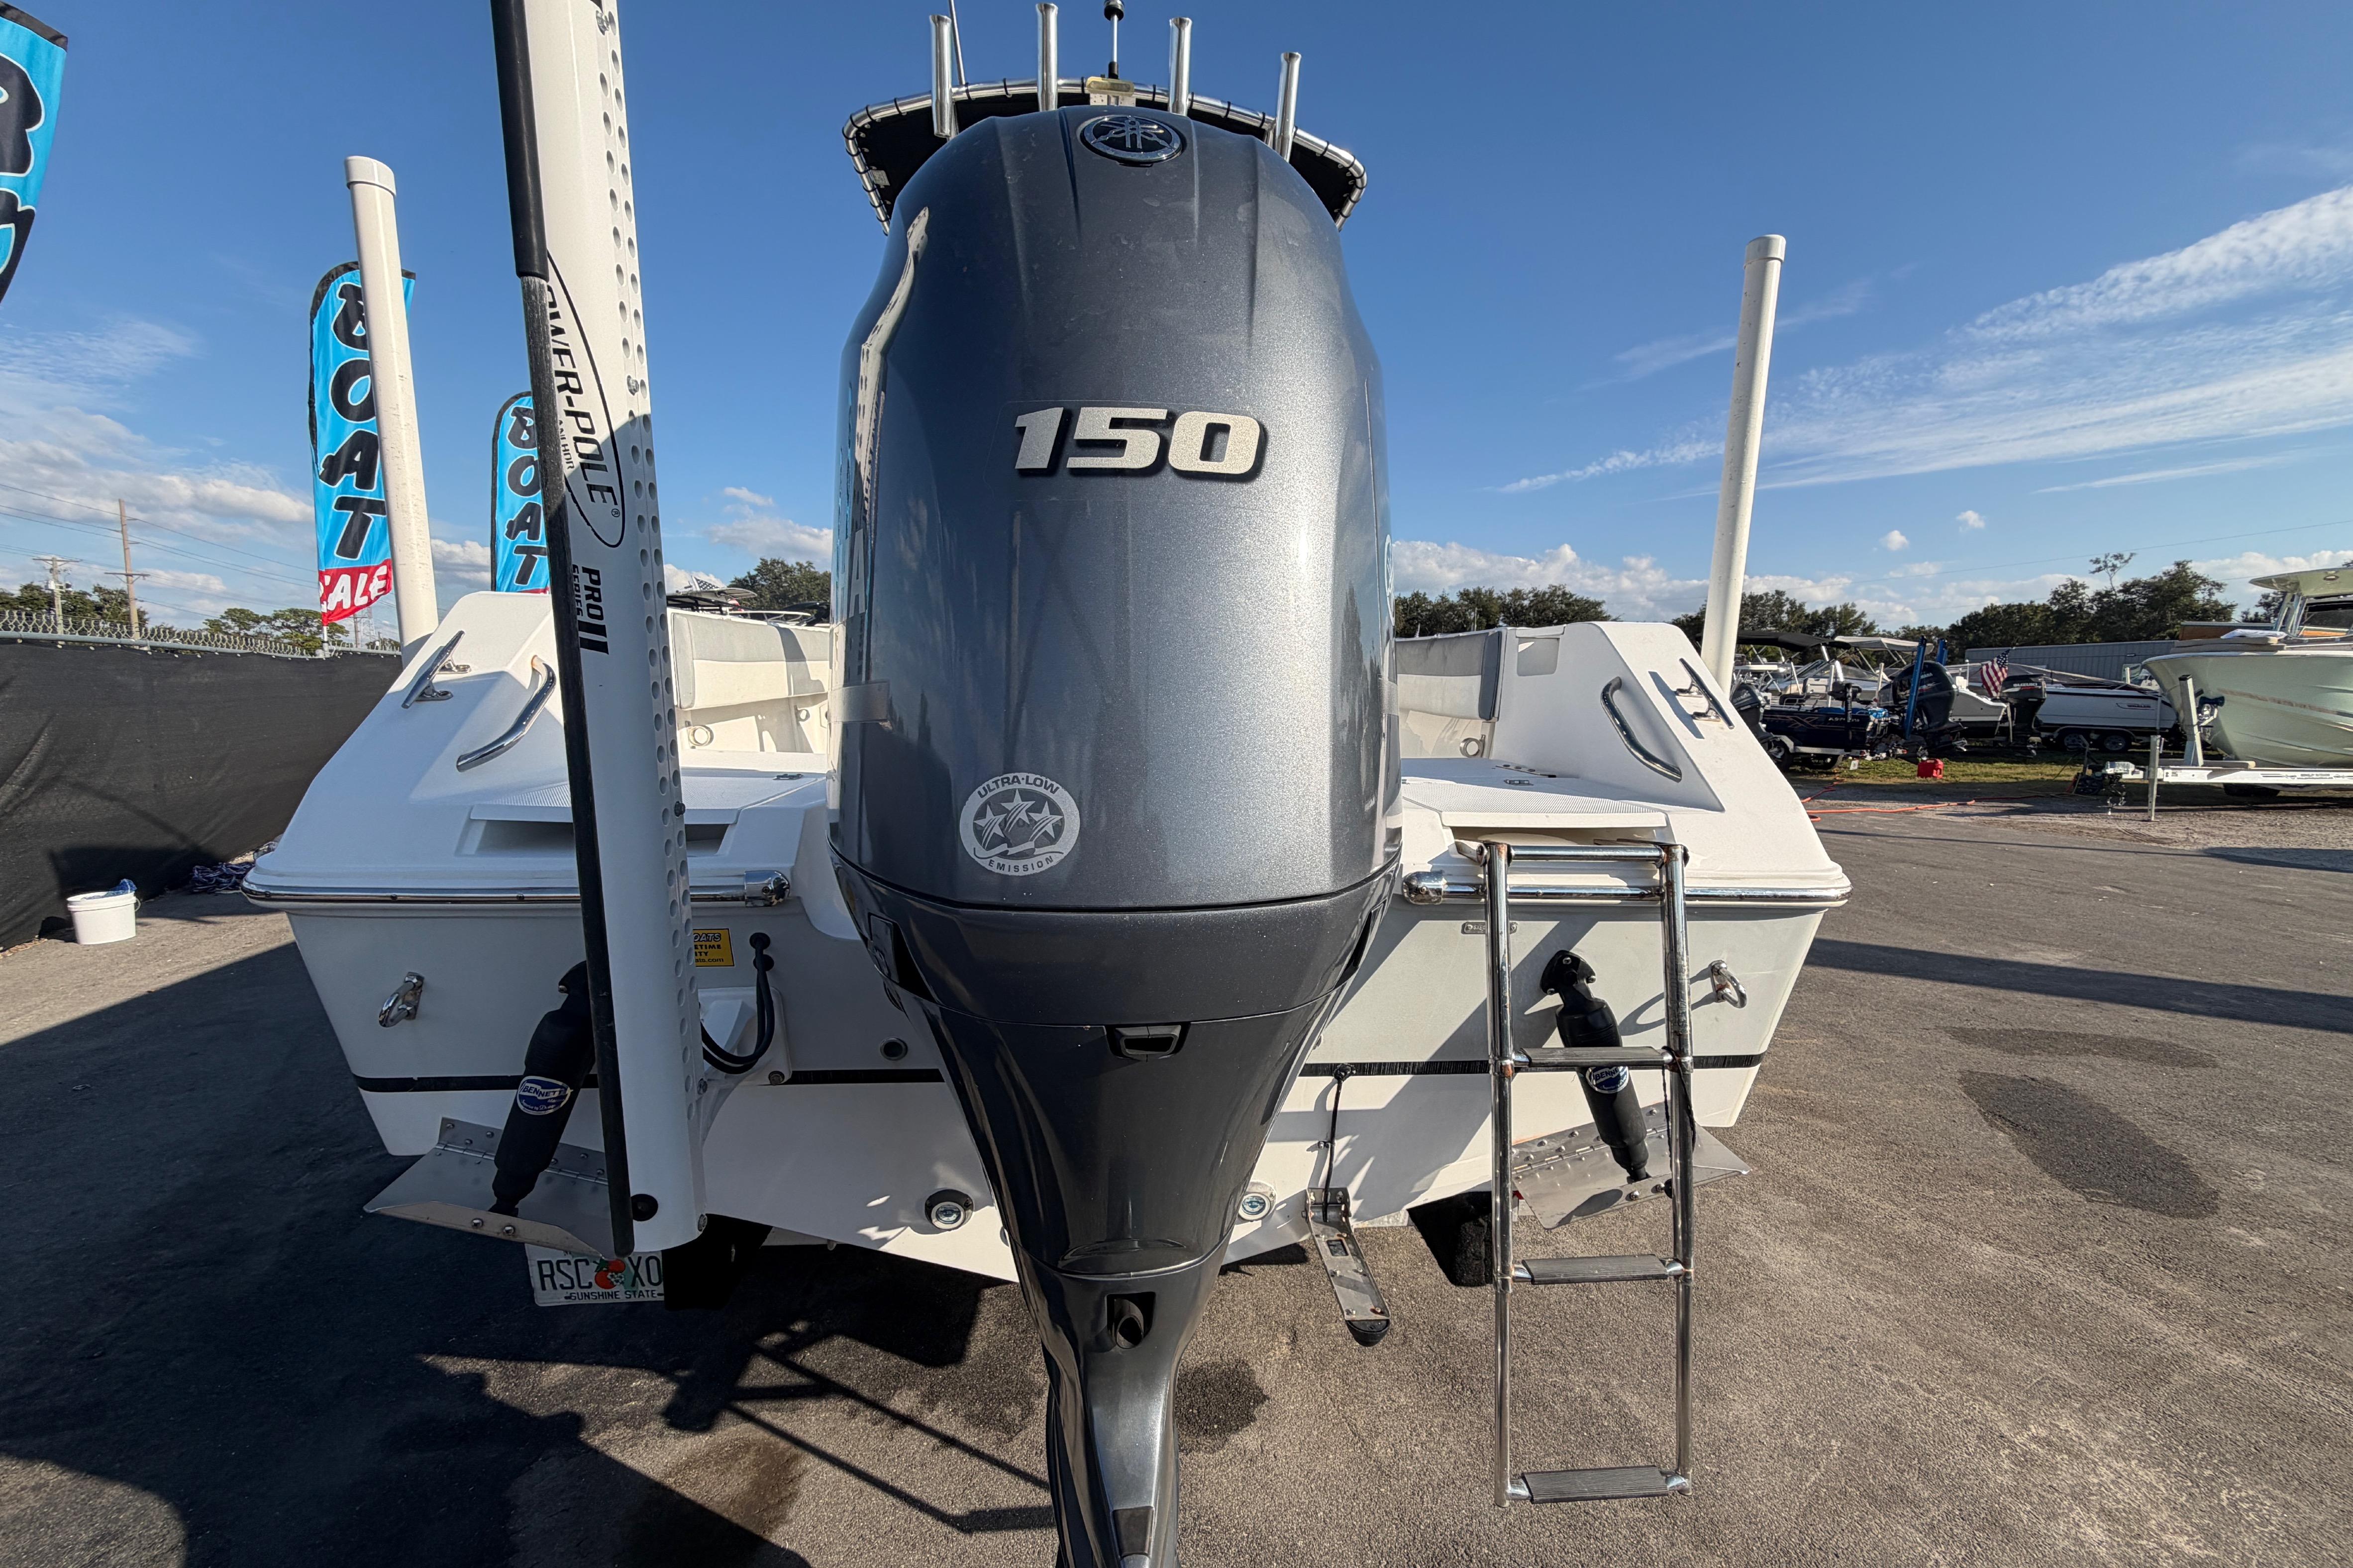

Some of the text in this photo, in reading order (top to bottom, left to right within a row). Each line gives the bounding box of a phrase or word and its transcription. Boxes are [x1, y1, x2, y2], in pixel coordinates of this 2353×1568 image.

[319, 282, 386, 560] BOAT
[1015, 407, 1260, 475] 150
[505, 405, 547, 586] BOAT
[582, 566, 604, 621] PRO
[988, 856, 1053, 872] EMISSION
[1595, 1068, 1620, 1080] BENN
[522, 1085, 564, 1097] BENNETT
[537, 1259, 593, 1291] RSC
[570, 1289, 657, 1301] SUNSHINE STATE
